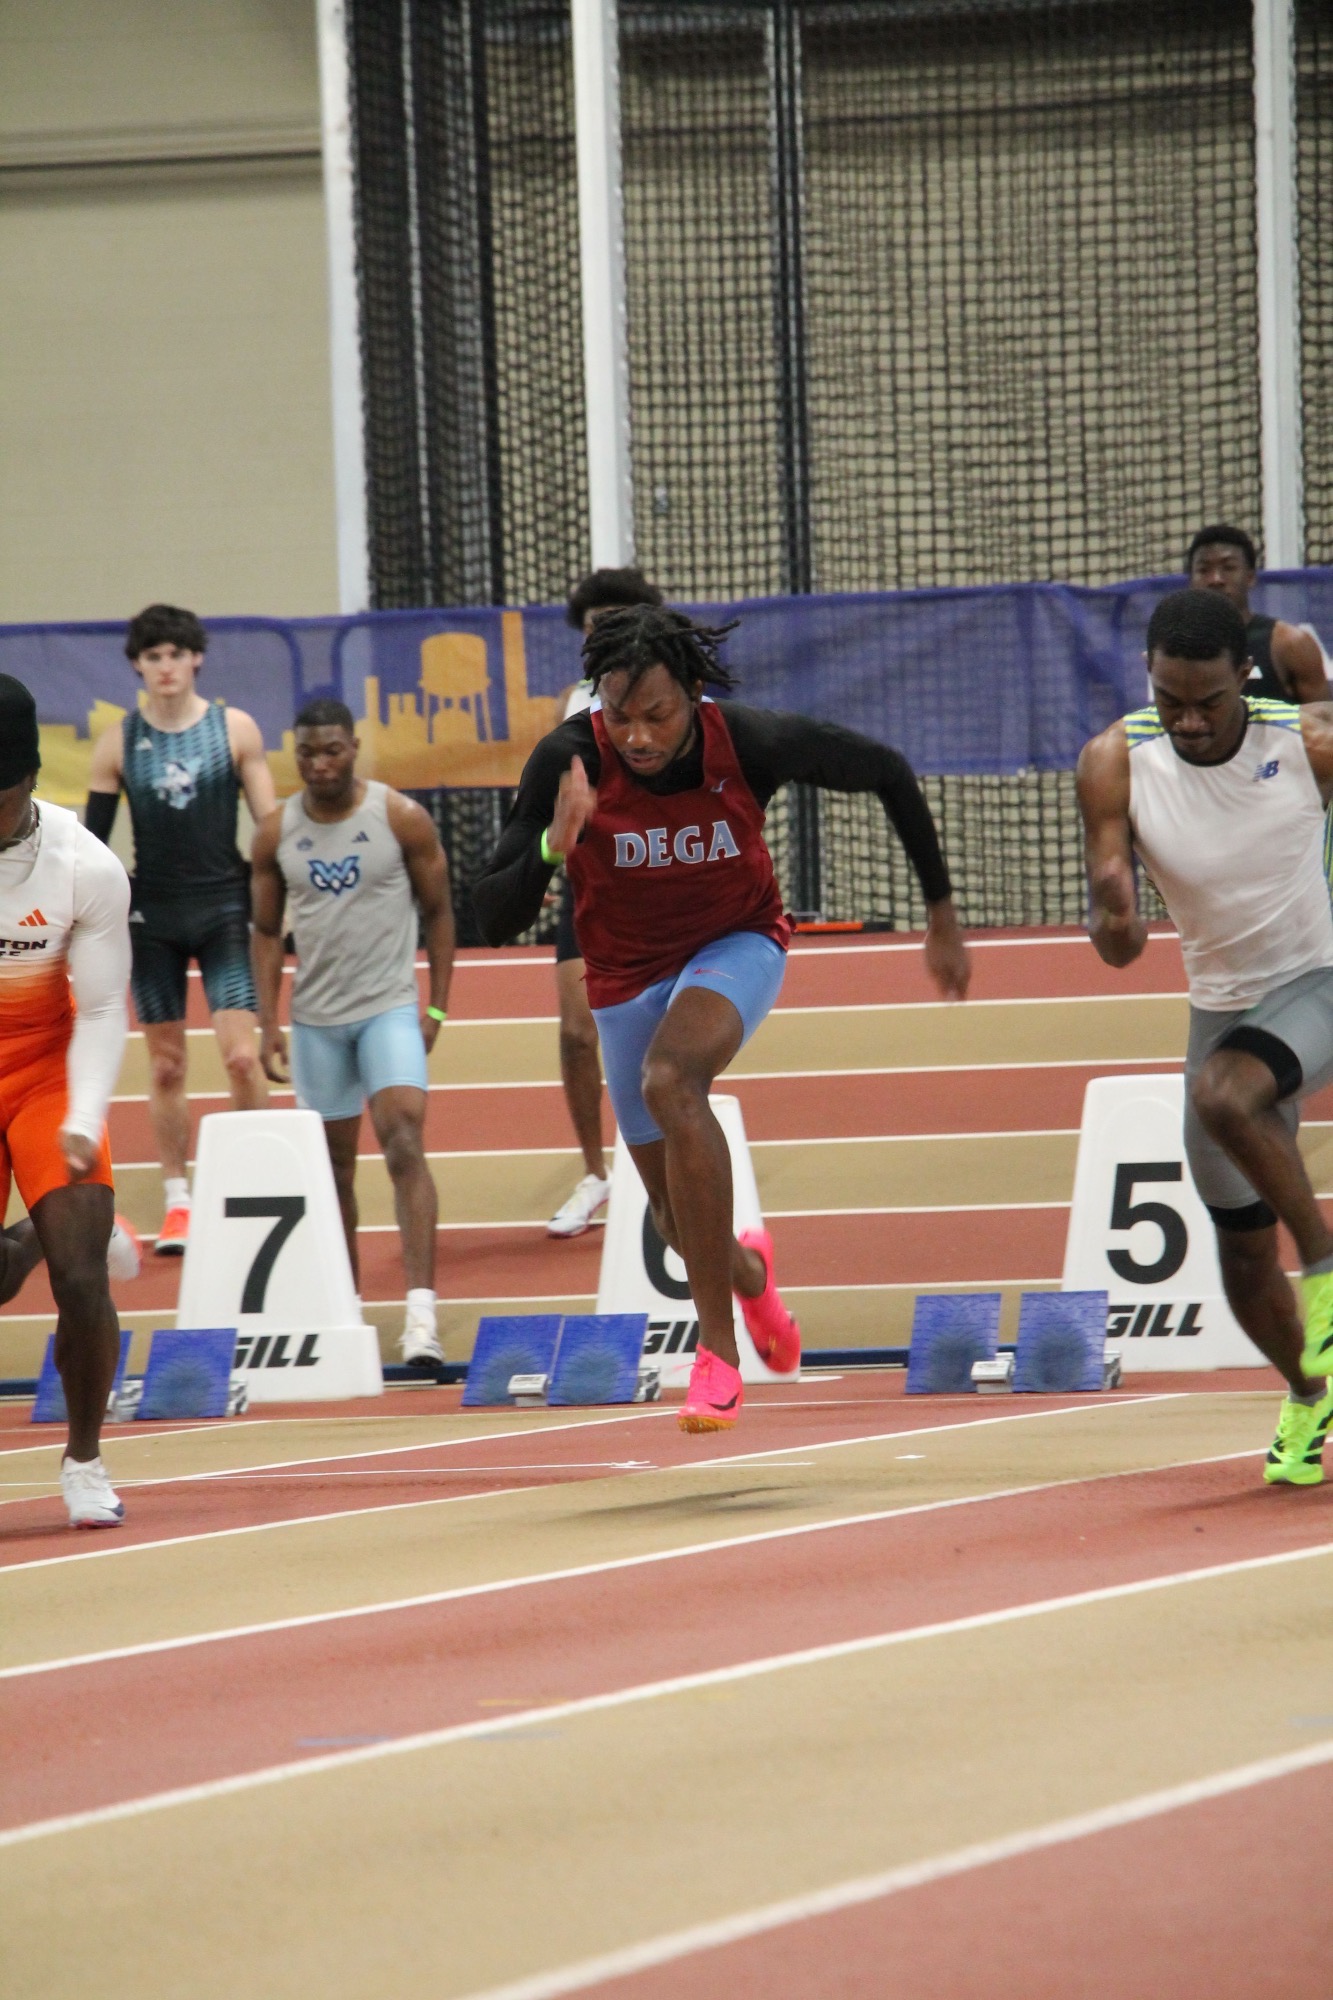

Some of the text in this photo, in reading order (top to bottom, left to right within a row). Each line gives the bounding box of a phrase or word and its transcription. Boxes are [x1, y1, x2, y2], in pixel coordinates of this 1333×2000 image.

[613, 820, 741, 868] DEGA
[224, 1196, 306, 1314] 7
[1106, 1161, 1188, 1285] 5
[1106, 1303, 1203, 1338] GILL
